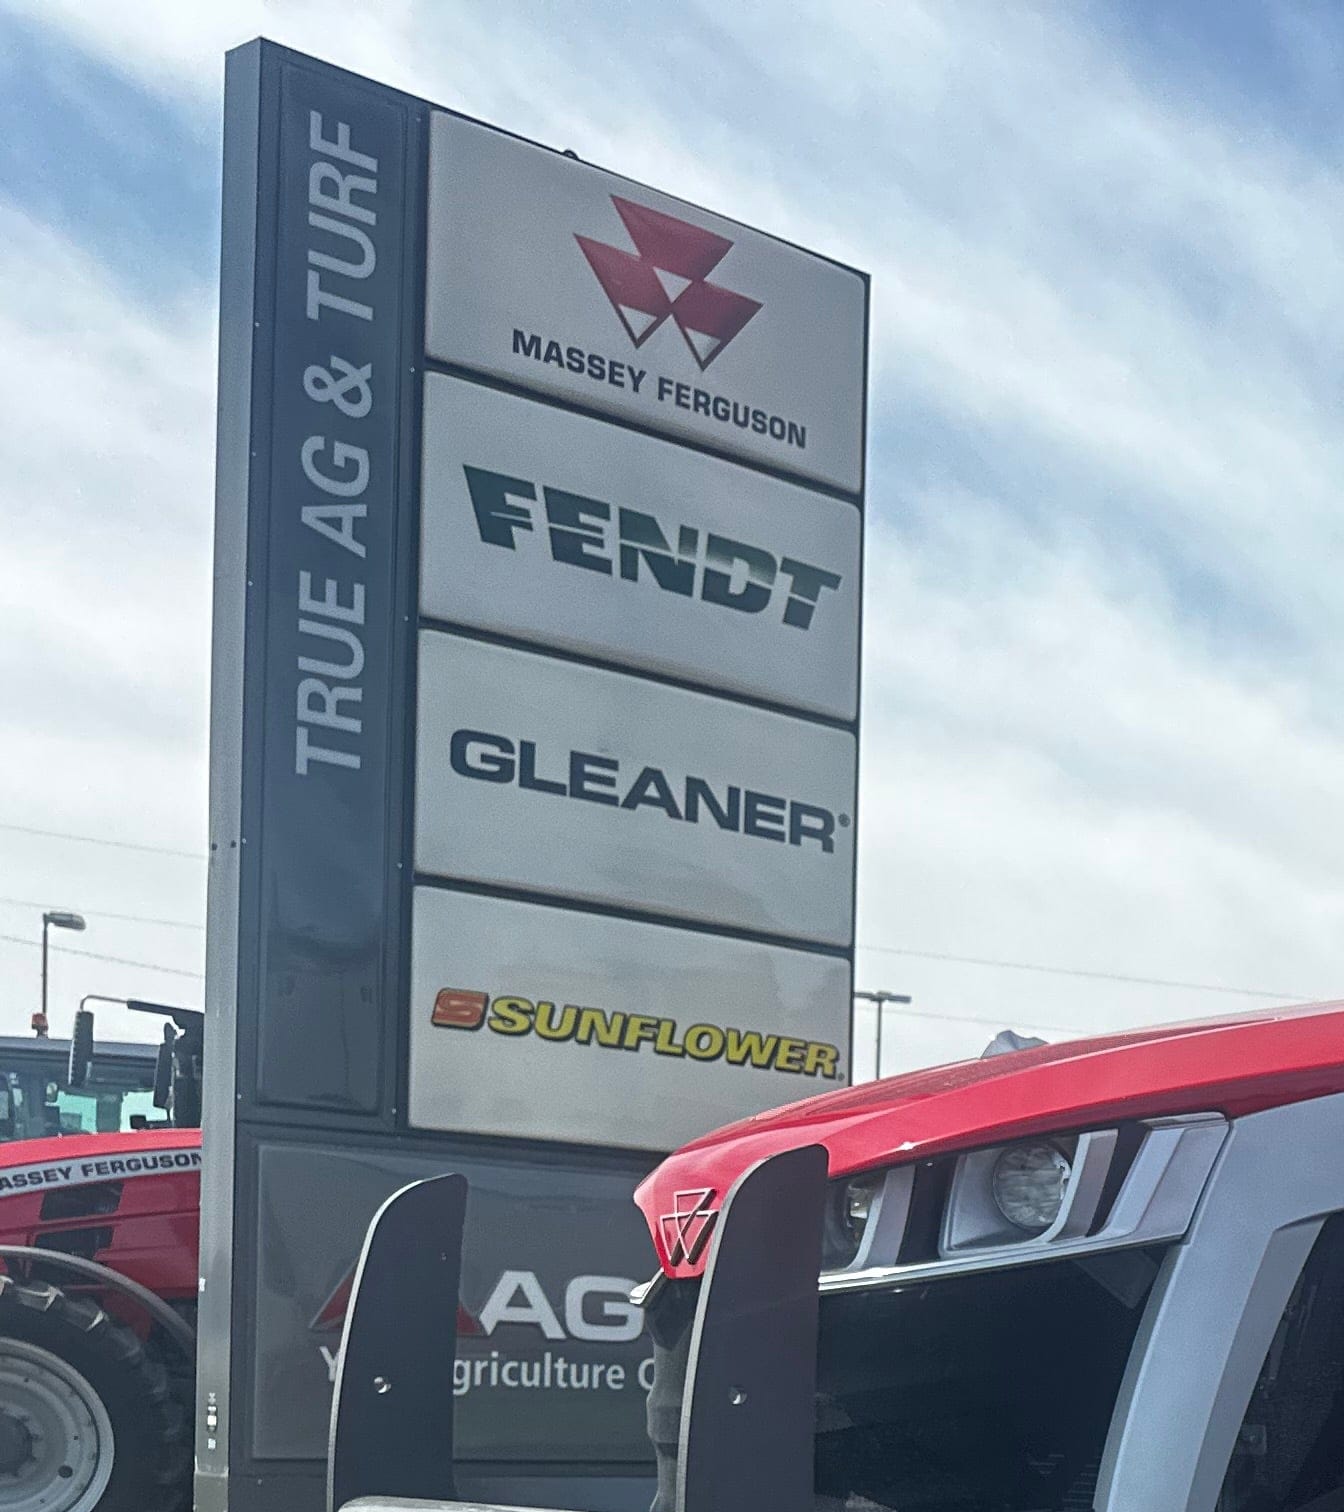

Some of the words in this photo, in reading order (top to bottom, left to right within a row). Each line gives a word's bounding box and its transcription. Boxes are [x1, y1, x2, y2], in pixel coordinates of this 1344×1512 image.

[306, 110, 380, 321] TURF
[303, 354, 374, 419] &
[511, 329, 648, 394] MASSEY
[657, 376, 807, 449] FERGUSON
[299, 435, 369, 559] AG
[462, 463, 842, 631] FENDT
[295, 571, 366, 775] TRUE
[80, 1152, 202, 1179] FERGUSON
